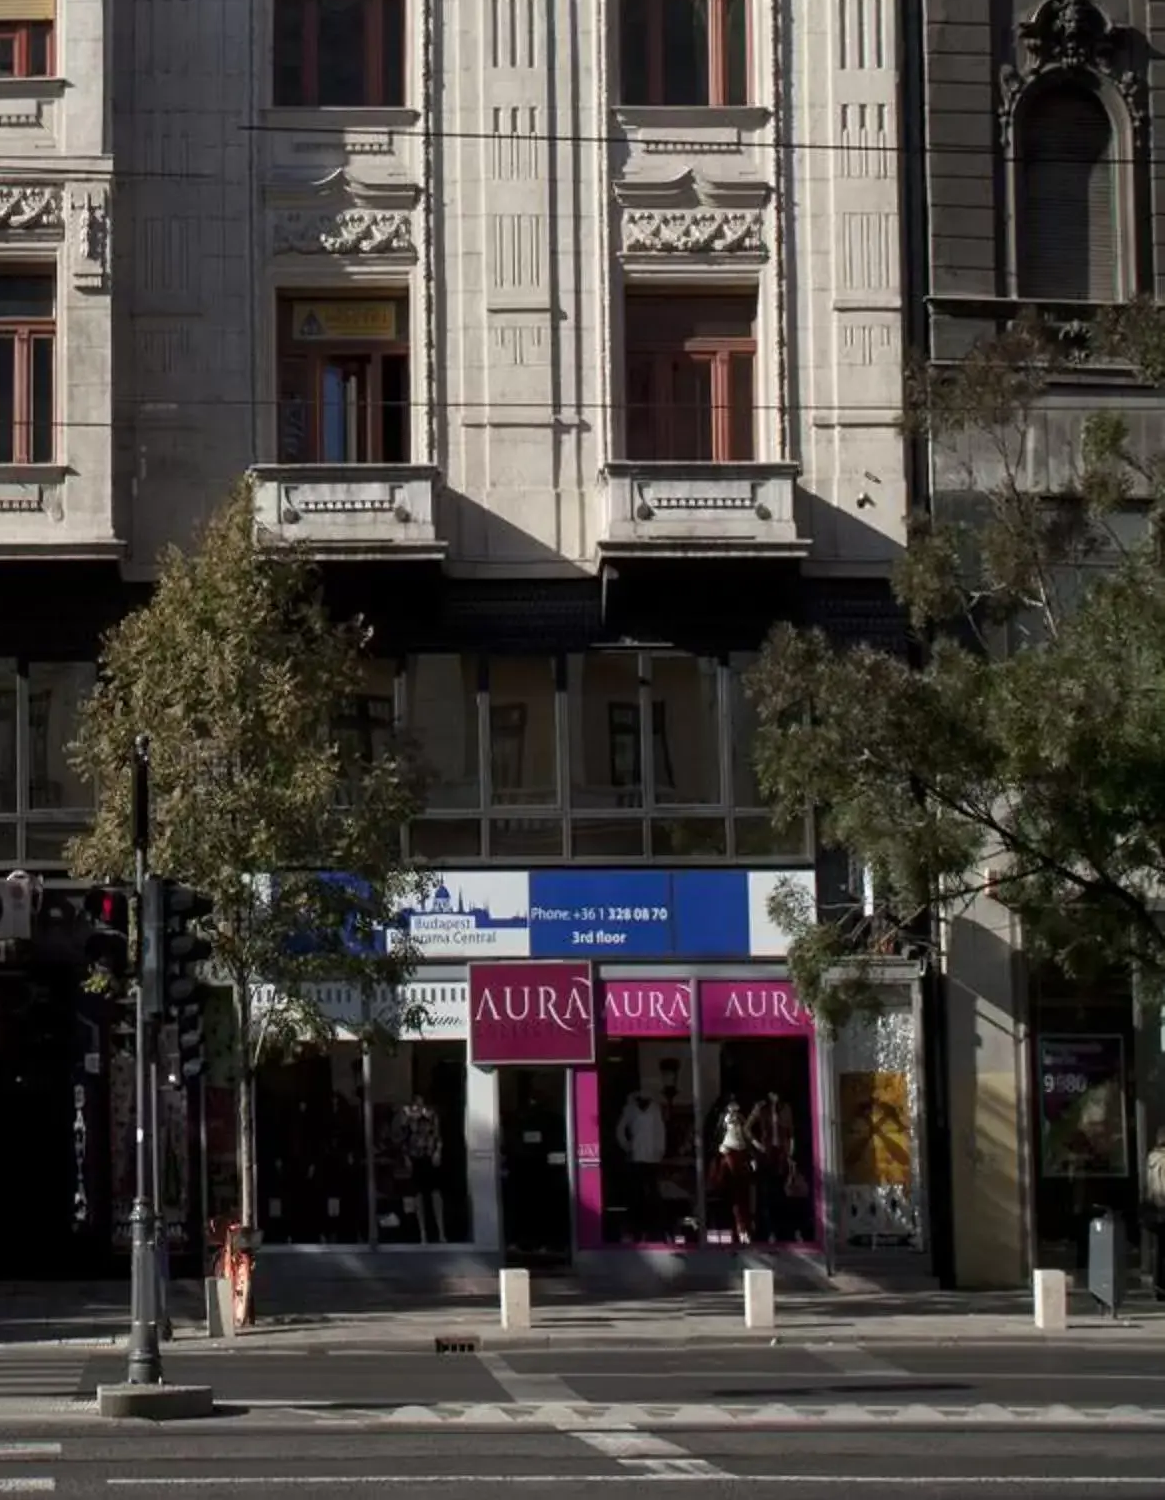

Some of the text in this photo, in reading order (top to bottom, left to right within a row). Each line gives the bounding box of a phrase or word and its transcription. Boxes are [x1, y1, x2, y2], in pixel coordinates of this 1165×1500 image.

[573, 907, 596, 921] +36
[608, 907, 631, 921] 328
[652, 907, 668, 921] 70
[415, 917, 470, 931] Budapest
[391, 930, 496, 945] Porama Central
[572, 930, 627, 944] 3rd floor
[475, 978, 592, 1031] AURA
[604, 985, 692, 1025] AURA
